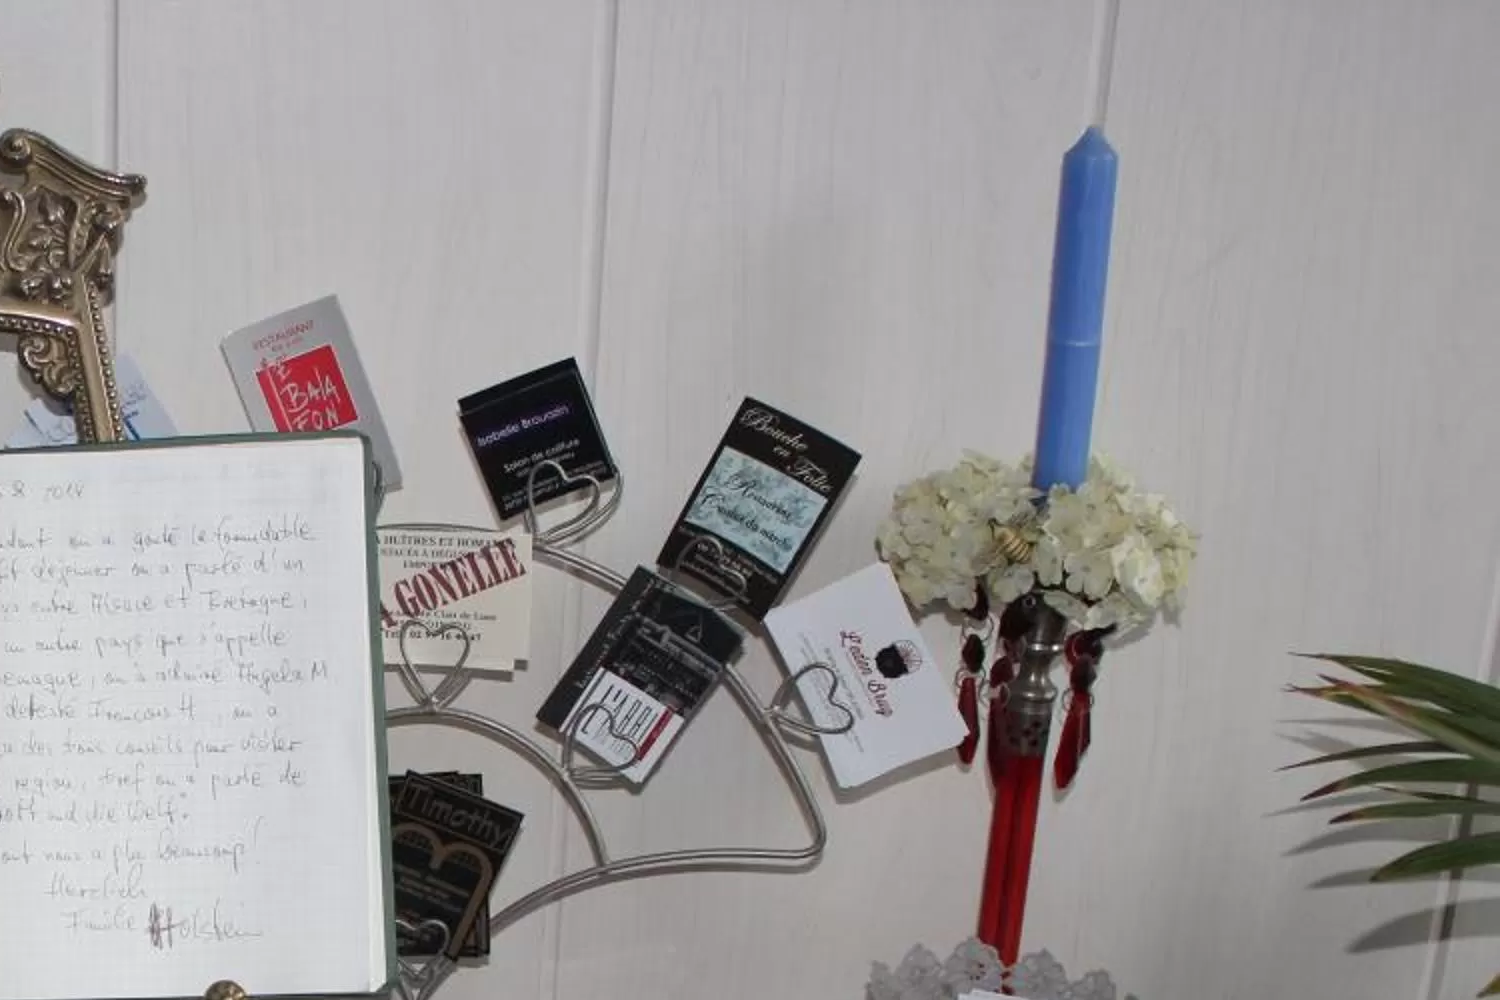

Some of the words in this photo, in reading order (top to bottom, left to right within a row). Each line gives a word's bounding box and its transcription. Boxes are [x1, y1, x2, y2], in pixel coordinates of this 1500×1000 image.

[740, 407, 808, 451] Bouche
[773, 446, 791, 458] en
[786, 455, 833, 492] Folie
[406, 781, 514, 851] Timothy
